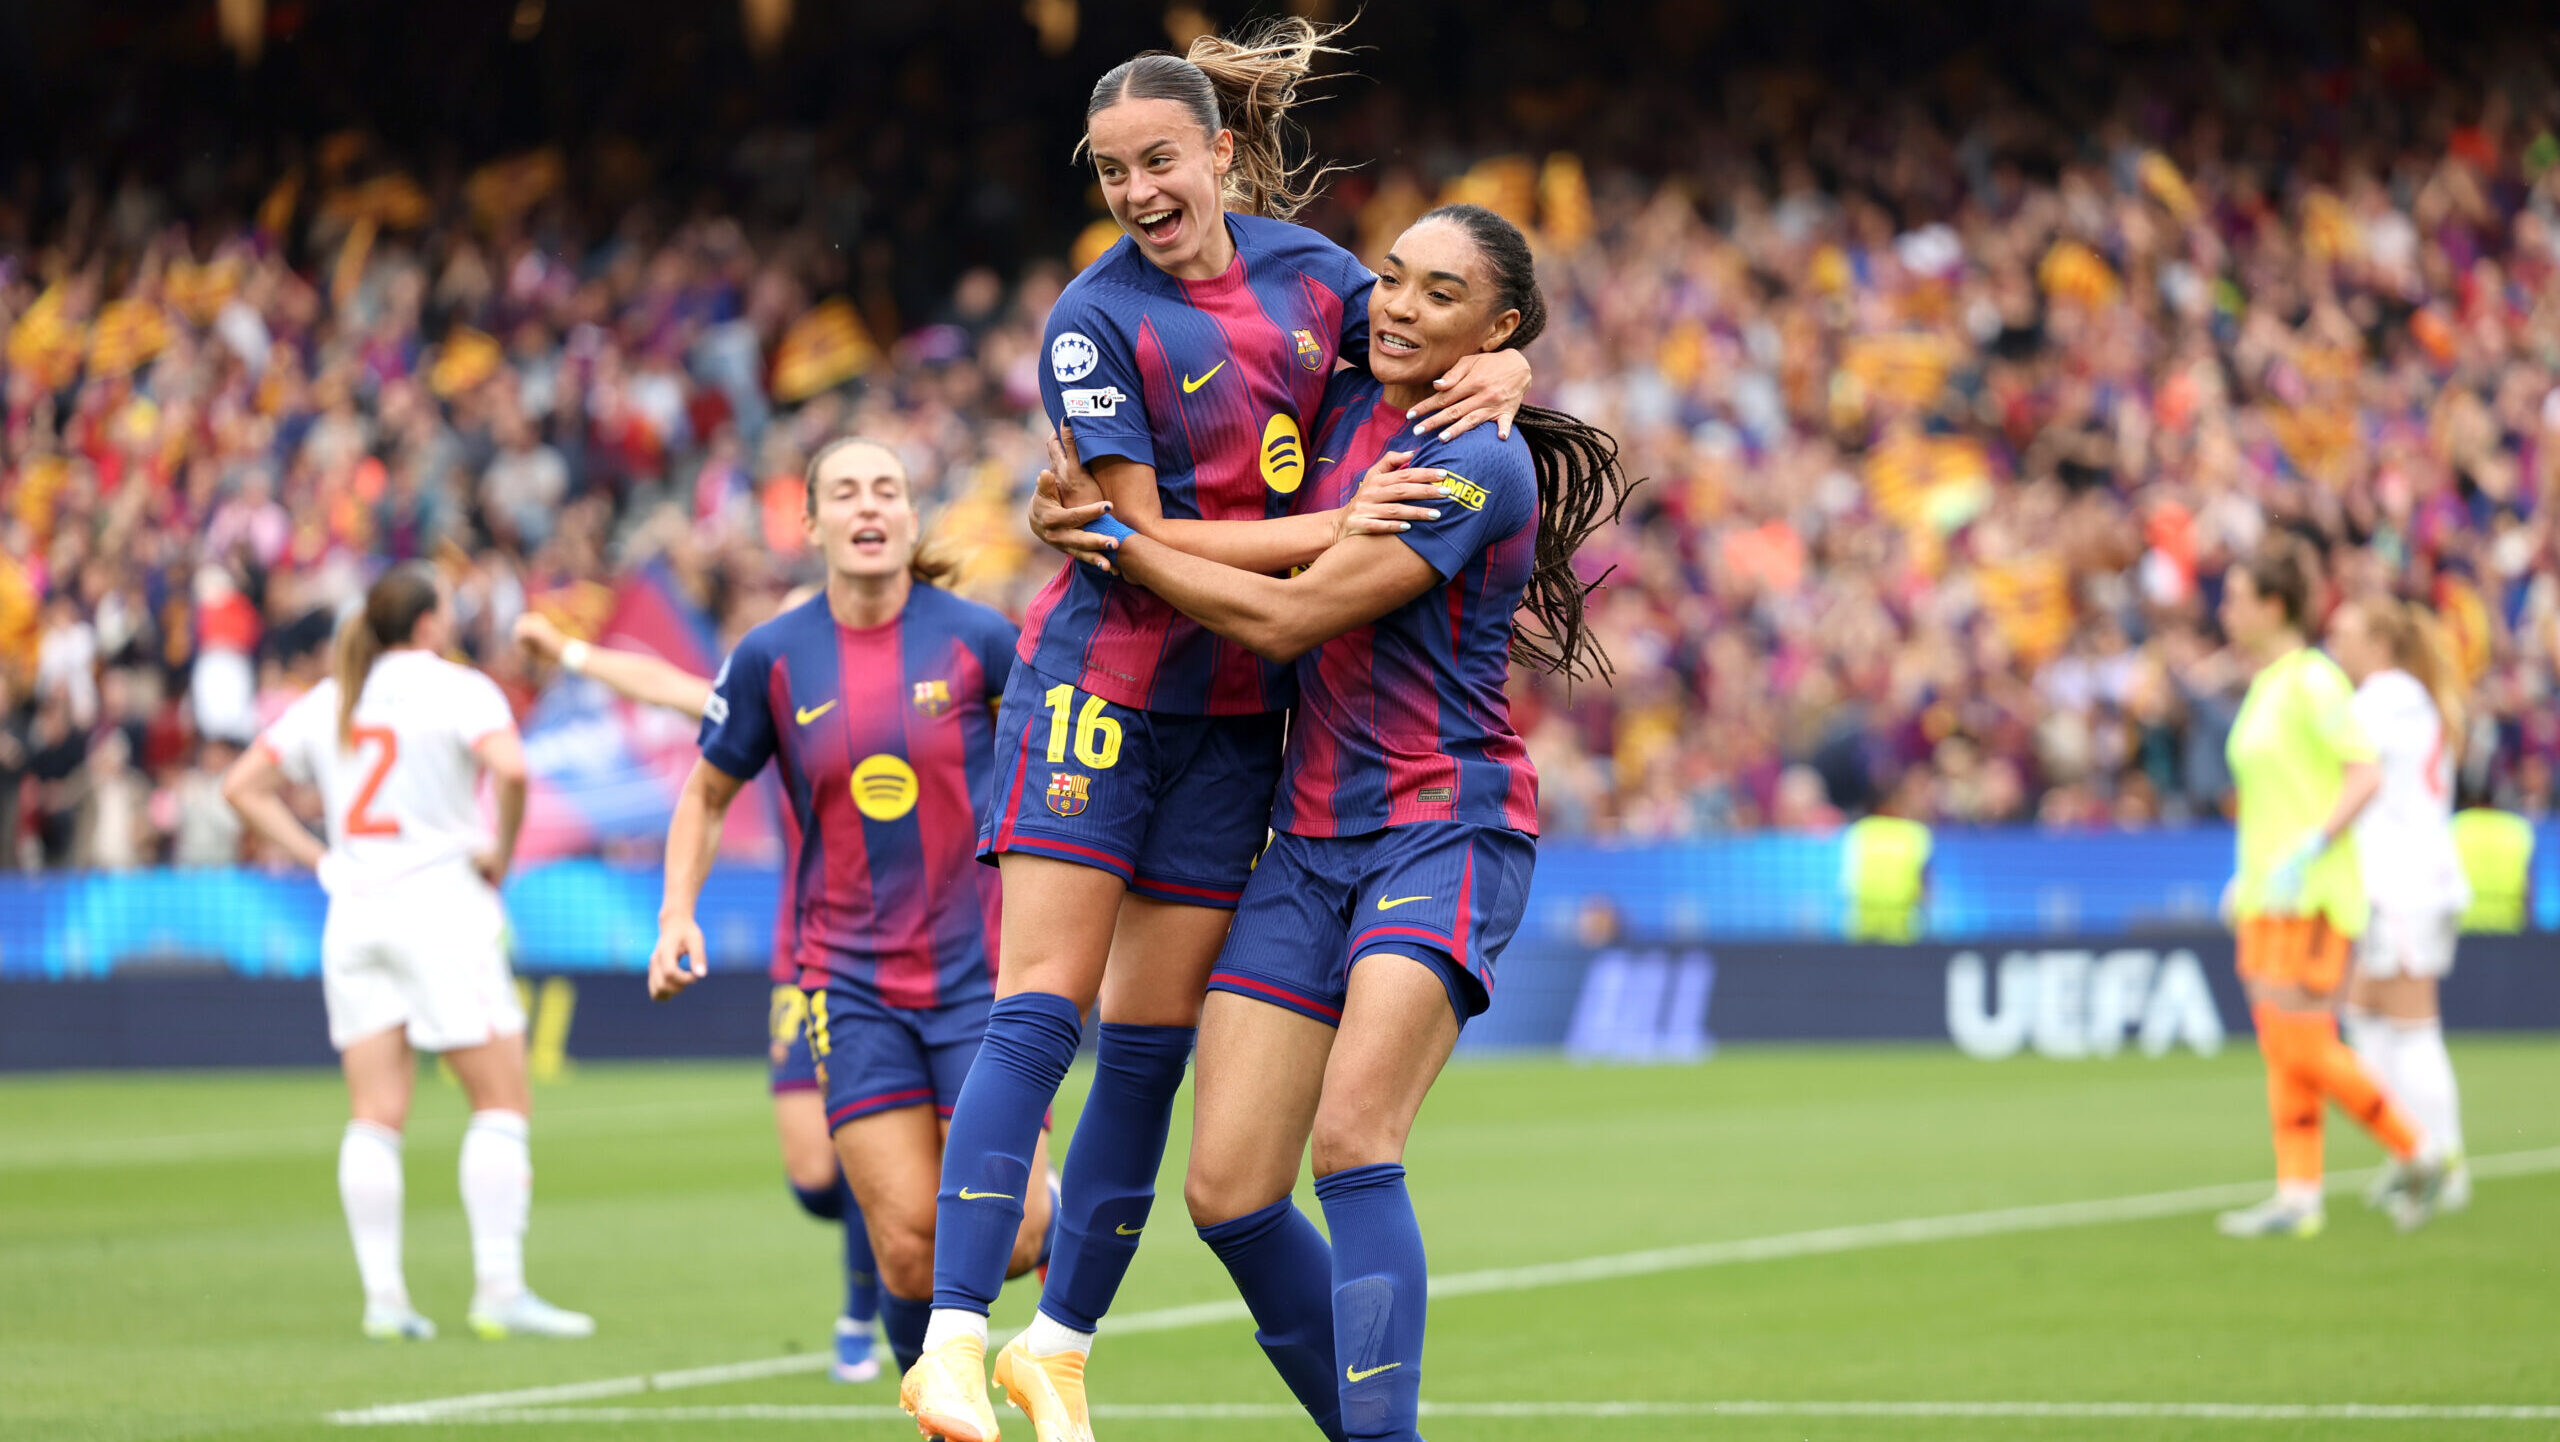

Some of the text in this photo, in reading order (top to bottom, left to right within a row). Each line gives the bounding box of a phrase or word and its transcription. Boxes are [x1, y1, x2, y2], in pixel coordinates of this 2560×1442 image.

[1091, 395, 1112, 409] 10
[1436, 477, 1487, 507] MBO
[1045, 683, 1123, 769] 16
[347, 724, 400, 836] 2
[1946, 950, 2224, 1058] UEFA
